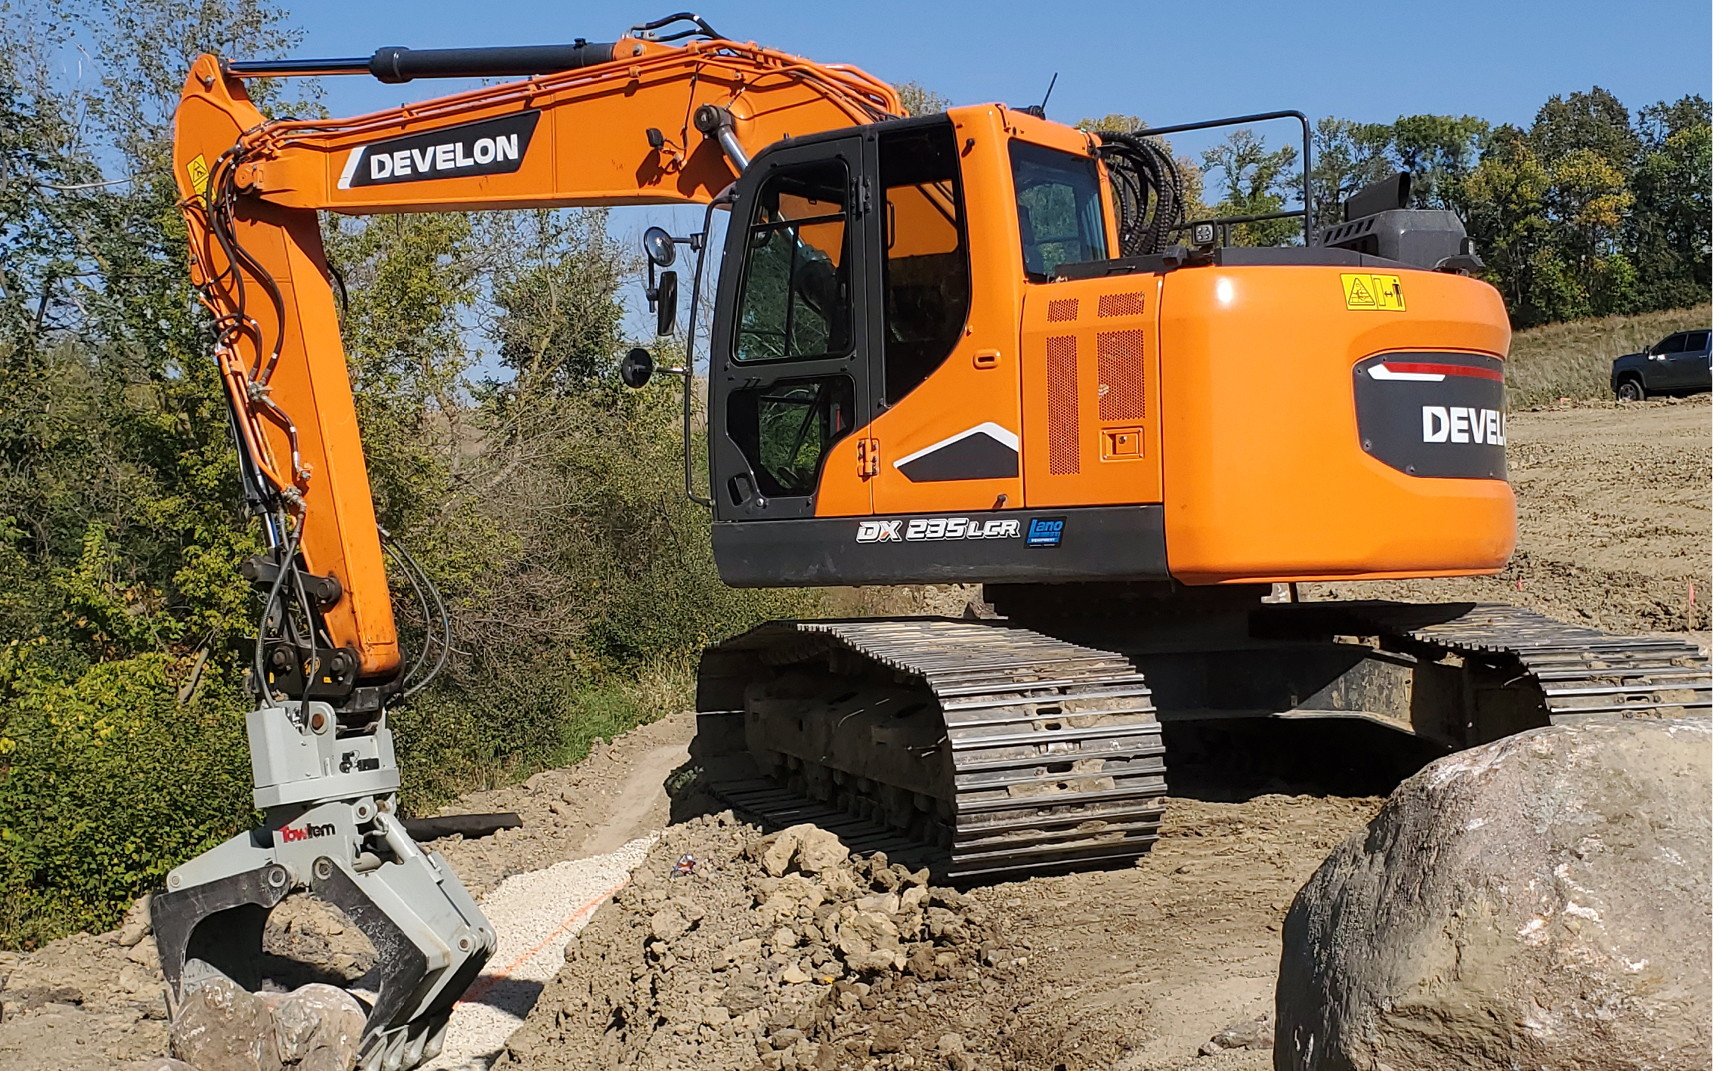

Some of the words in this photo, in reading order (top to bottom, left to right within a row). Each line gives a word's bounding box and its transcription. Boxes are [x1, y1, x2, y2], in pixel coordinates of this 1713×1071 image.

[370, 133, 519, 180] DEVELON
[1422, 405, 1506, 447] DEVEL
[856, 520, 902, 543] DX
[1029, 519, 1063, 538] Lano
